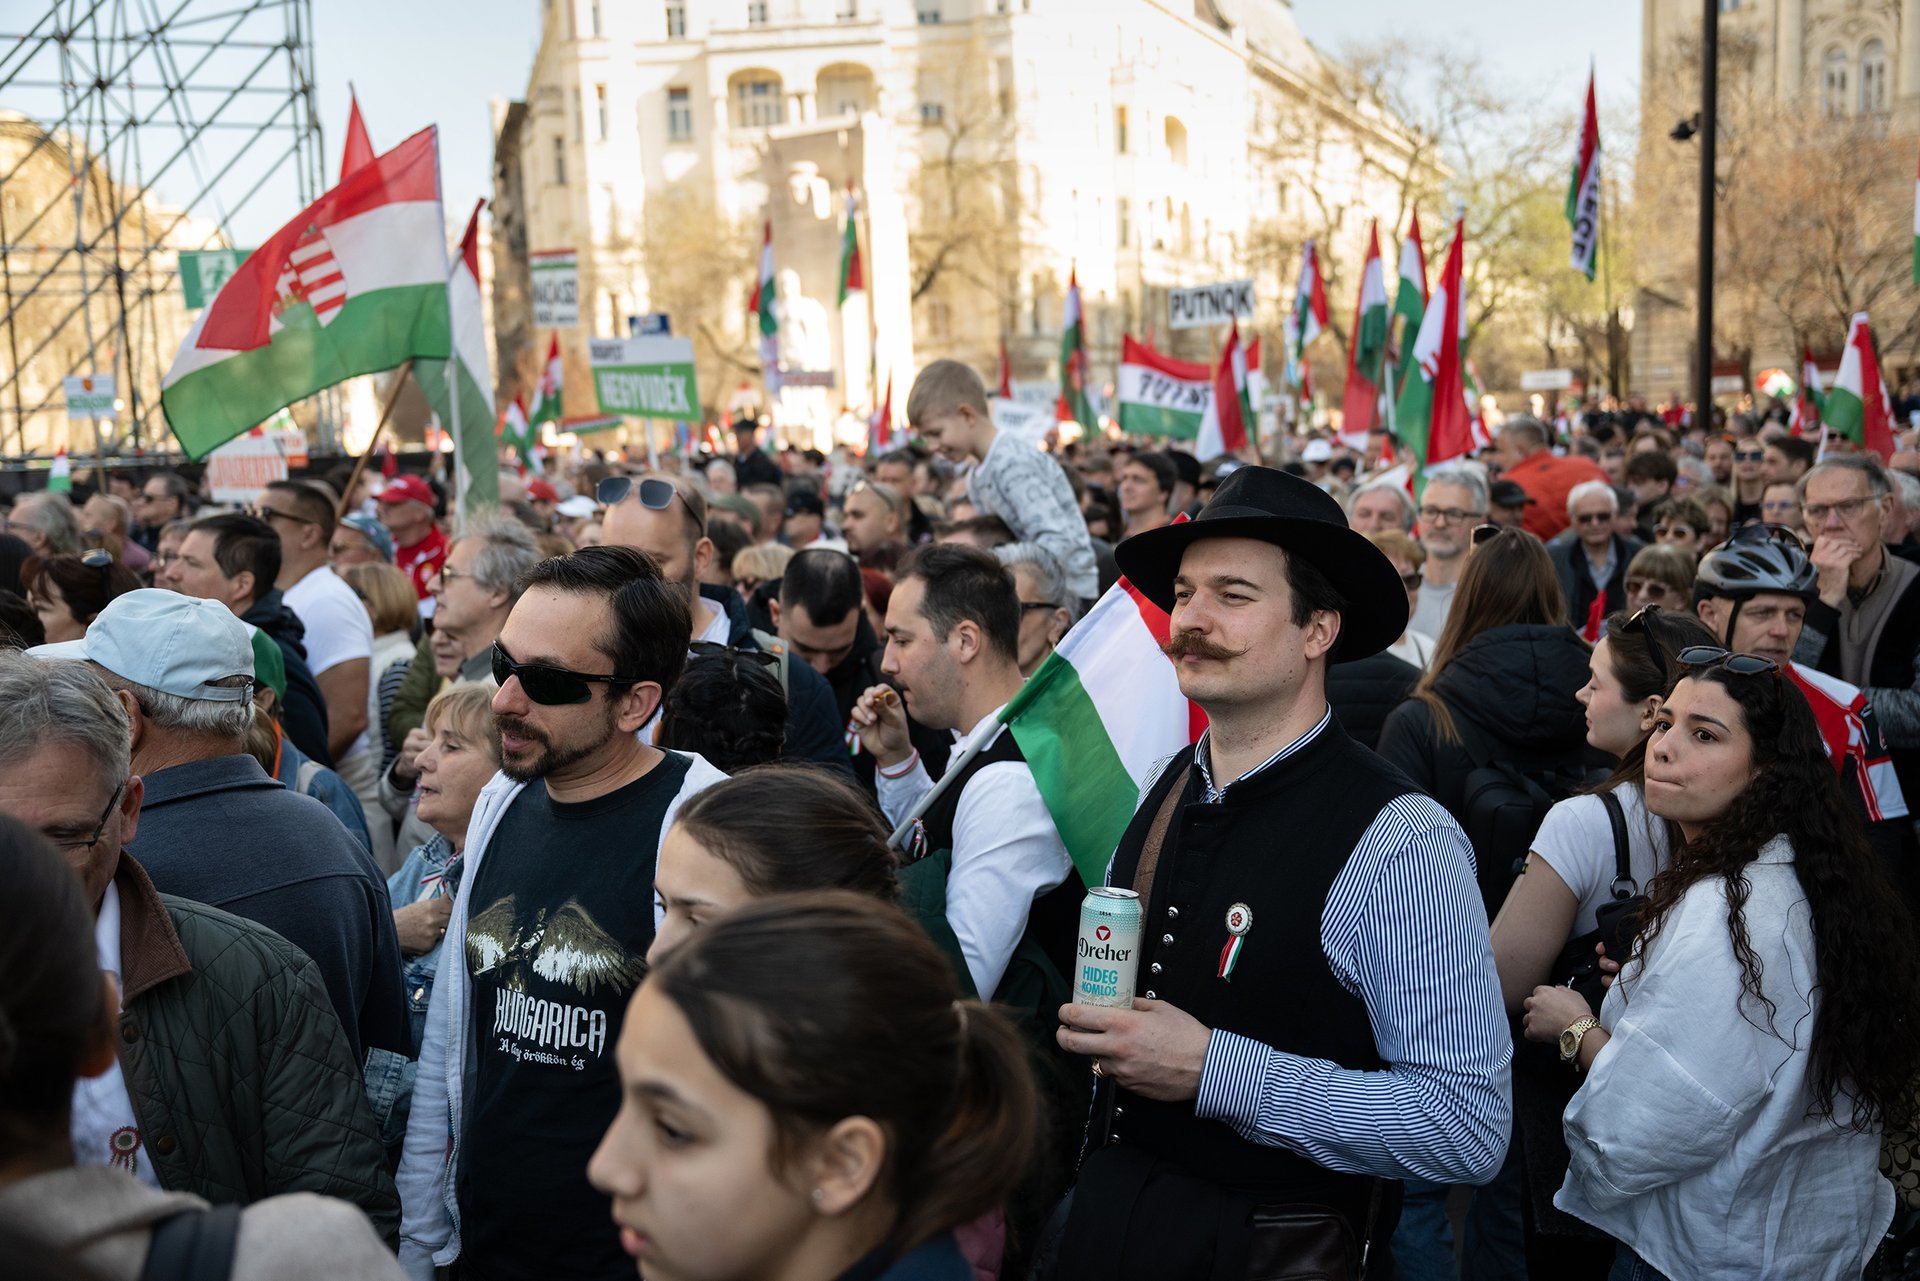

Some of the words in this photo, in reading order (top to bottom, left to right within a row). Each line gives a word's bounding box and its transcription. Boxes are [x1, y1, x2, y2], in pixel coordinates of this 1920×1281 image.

[1171, 285, 1250, 321] PUTNOK
[599, 366, 691, 413] HEGYVIDÉK
[1078, 937, 1132, 962] Dreher
[1081, 981, 1117, 997] KOMLÓS
[1082, 964, 1118, 985] HIDEG
[493, 987, 607, 1058] HUNGARICA
[498, 1038, 509, 1053] A
[523, 1049, 568, 1066] örökkön
[570, 1054, 586, 1071] ég
